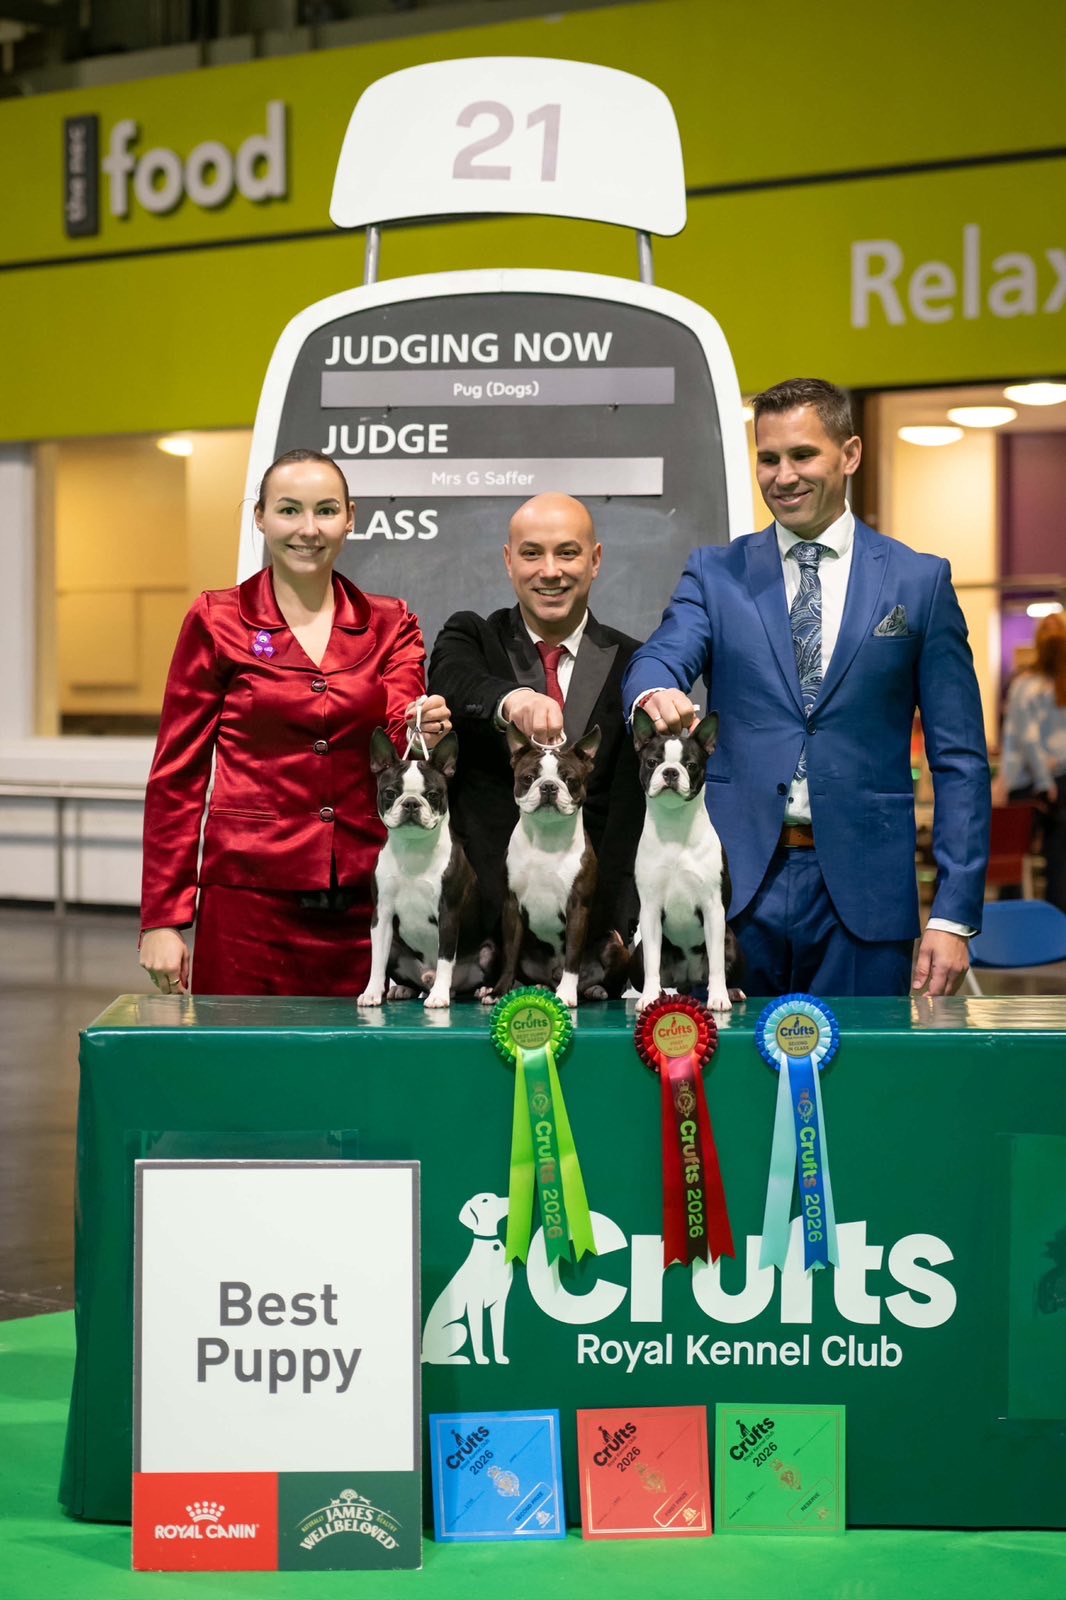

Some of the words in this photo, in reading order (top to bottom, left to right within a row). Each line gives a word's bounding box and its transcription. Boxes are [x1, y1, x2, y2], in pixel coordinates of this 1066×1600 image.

[103, 100, 286, 217] food
[451, 100, 562, 183] 21
[325, 333, 499, 366] JUDGING
[514, 331, 613, 362] NOW
[453, 382, 482, 399] Pug
[486, 381, 540, 398] (Dogs)
[321, 424, 448, 455] JUDGE
[431, 472, 461, 485] Mrs
[466, 472, 480, 485] G
[485, 471, 535, 486] Saffer
[346, 509, 439, 541] LASS
[513, 1018, 548, 1030] Crufts
[658, 1025, 693, 1038] Crufts
[780, 1026, 815, 1037] Crufts
[535, 1120, 556, 1185] Crufts
[680, 1120, 700, 1184] Crufts
[800, 1126, 818, 1189] Crufts
[543, 1188, 563, 1239] 2026
[687, 1188, 704, 1238] 2026
[805, 1193, 823, 1243] 2026
[220, 1281, 338, 1326] Best
[197, 1337, 362, 1394] Puppy
[577, 1333, 672, 1373] Royal
[686, 1335, 809, 1367] Kennel
[821, 1335, 903, 1367] Club
[446, 1426, 490, 1470] Crufts
[593, 1422, 637, 1467] Crufts
[729, 1417, 775, 1461] Crufts
[752, 1441, 778, 1467] 2026
[469, 1449, 494, 1475] 2026
[616, 1446, 641, 1472] 2026
[154, 1524, 204, 1539] ROYAL
[205, 1523, 257, 1539] CANIN
[326, 1506, 374, 1522] JAMES
[299, 1519, 396, 1550] WELLBELOVED
